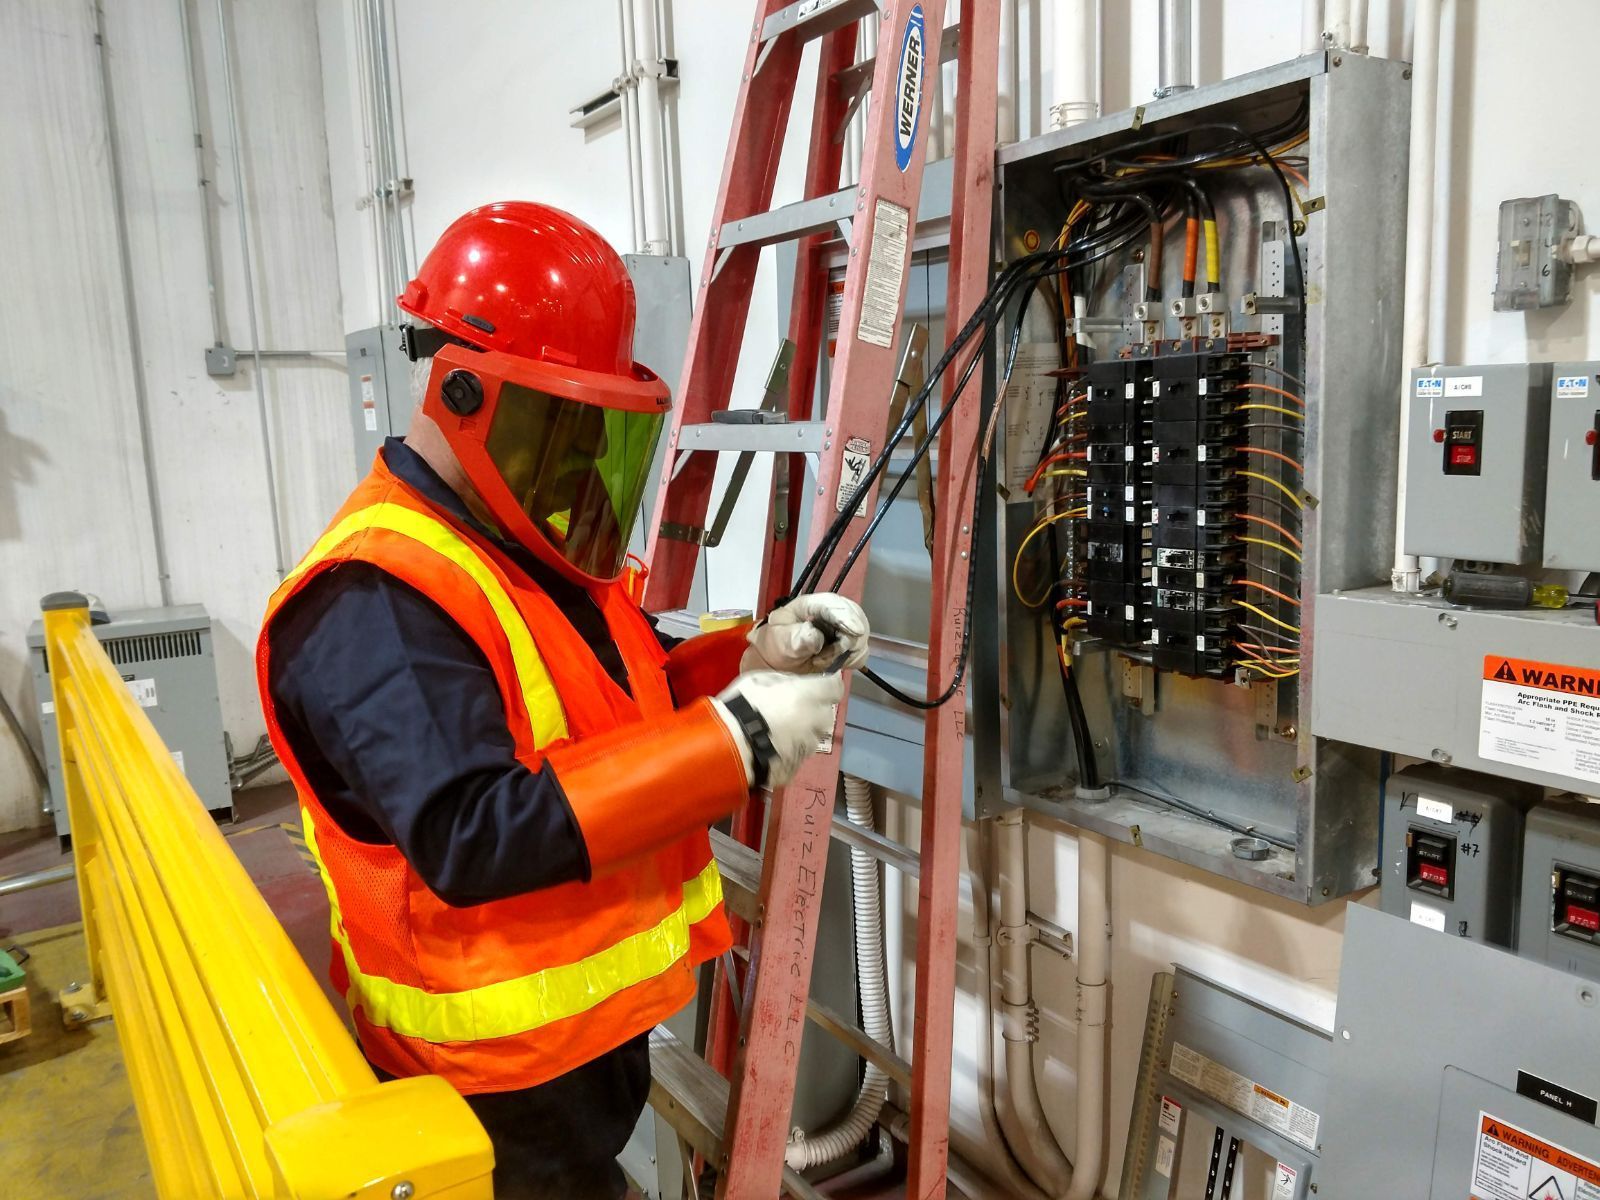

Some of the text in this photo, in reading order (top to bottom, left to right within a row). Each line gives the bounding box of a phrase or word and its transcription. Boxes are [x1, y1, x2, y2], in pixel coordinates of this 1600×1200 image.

[900, 33, 920, 137] WERNER
[1542, 264, 1550, 277] 6
[1559, 379, 1587, 387] EATON
[1452, 431, 1472, 439] START
[1456, 455, 1472, 463] STOP
[1518, 692, 1560, 705] Appropriate
[1562, 699, 1578, 707] PPE
[1532, 701, 1552, 710] Flash
[1570, 707, 1594, 717] Shock
[801, 786, 827, 860] Ruiz
[1418, 850, 1441, 860] START
[1461, 843, 1480, 858] #7
[1422, 871, 1445, 882] STOP
[789, 864, 816, 978] Electric
[1540, 1089, 1564, 1105] PANEL
[1484, 1135, 1529, 1160] Arc Flash And
[1502, 1130, 1549, 1159] WARNING
[1483, 1142, 1502, 1155] Shock
[1504, 1151, 1527, 1166] Hazard
